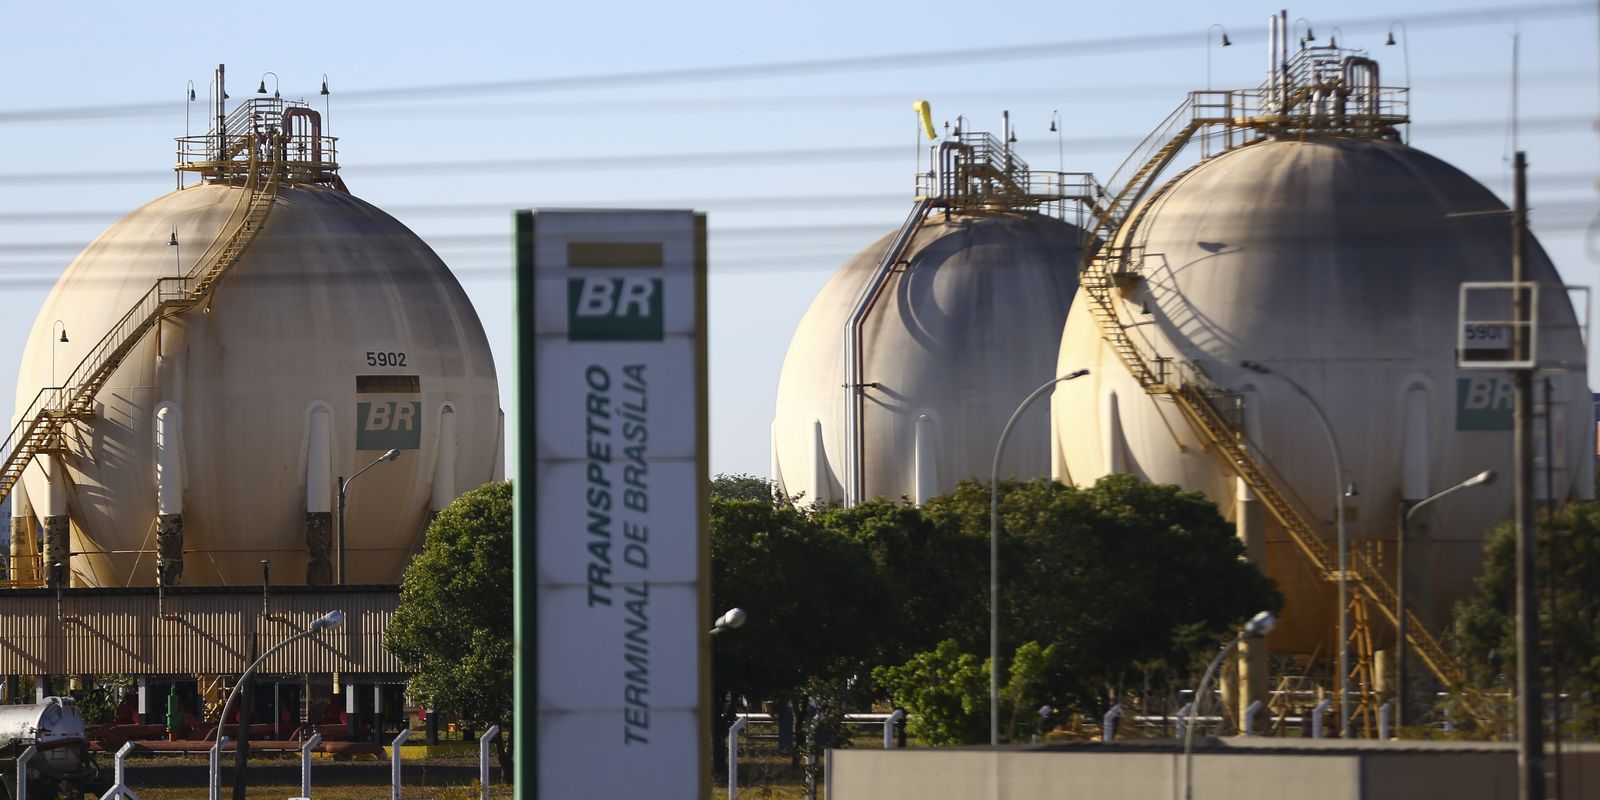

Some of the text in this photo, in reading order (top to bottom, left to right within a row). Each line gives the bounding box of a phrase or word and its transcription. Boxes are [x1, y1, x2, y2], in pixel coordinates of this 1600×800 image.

[576, 277, 655, 317] BR
[366, 351, 408, 367] 5902
[1463, 378, 1517, 410] BR
[364, 401, 416, 431] BR
[585, 364, 612, 609] TRANSPETRO
[615, 363, 650, 746] TERMINAL DE BRASÍLIA
